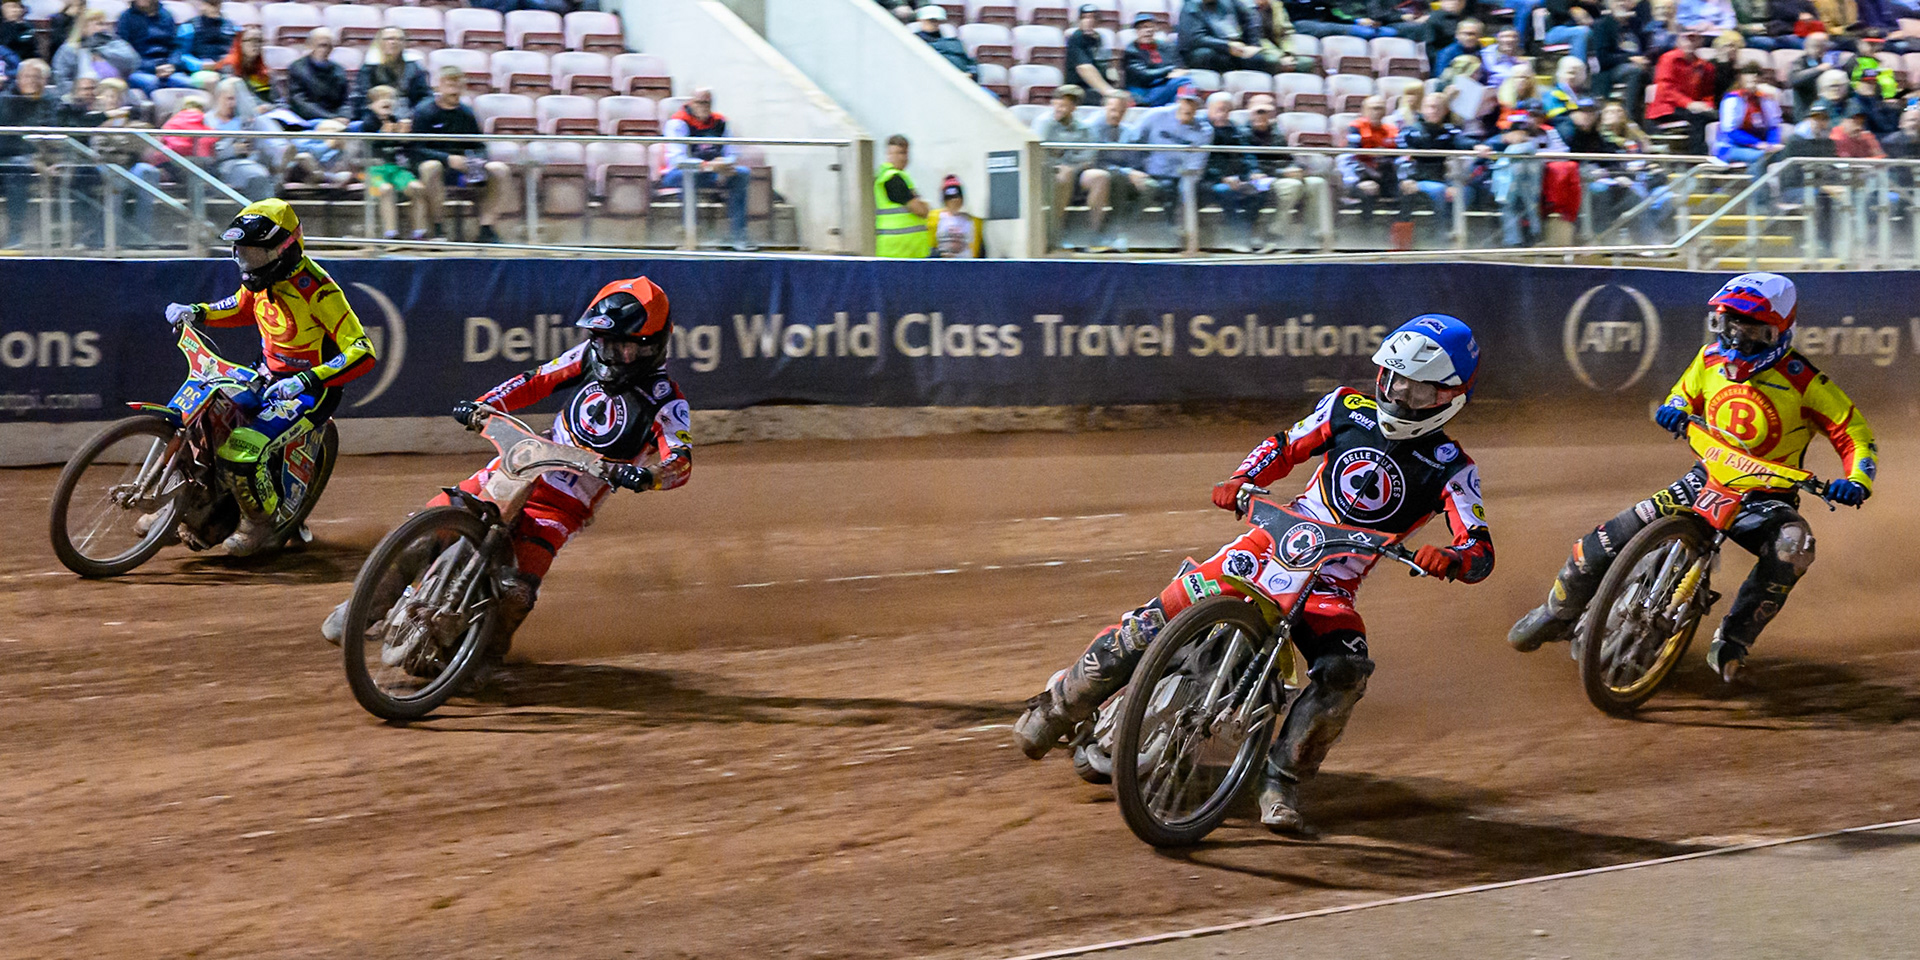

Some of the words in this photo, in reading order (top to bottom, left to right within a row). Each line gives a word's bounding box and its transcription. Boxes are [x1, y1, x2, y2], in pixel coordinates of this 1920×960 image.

[0, 331, 101, 367] ons
[463, 313, 721, 372] Delivng
[733, 311, 881, 358] World
[895, 312, 1023, 357] Class
[1033, 313, 1175, 357] Travel
[1190, 313, 1388, 357] Solutions
[1579, 321, 1642, 353] ATPI
[1348, 410, 1377, 429] ROWE
[1726, 401, 1758, 441] B
[1342, 451, 1371, 465] BELLE
[1390, 474, 1402, 498] ACES
[1705, 446, 1723, 461] OK
[1724, 452, 1776, 483] T-SHIRT
